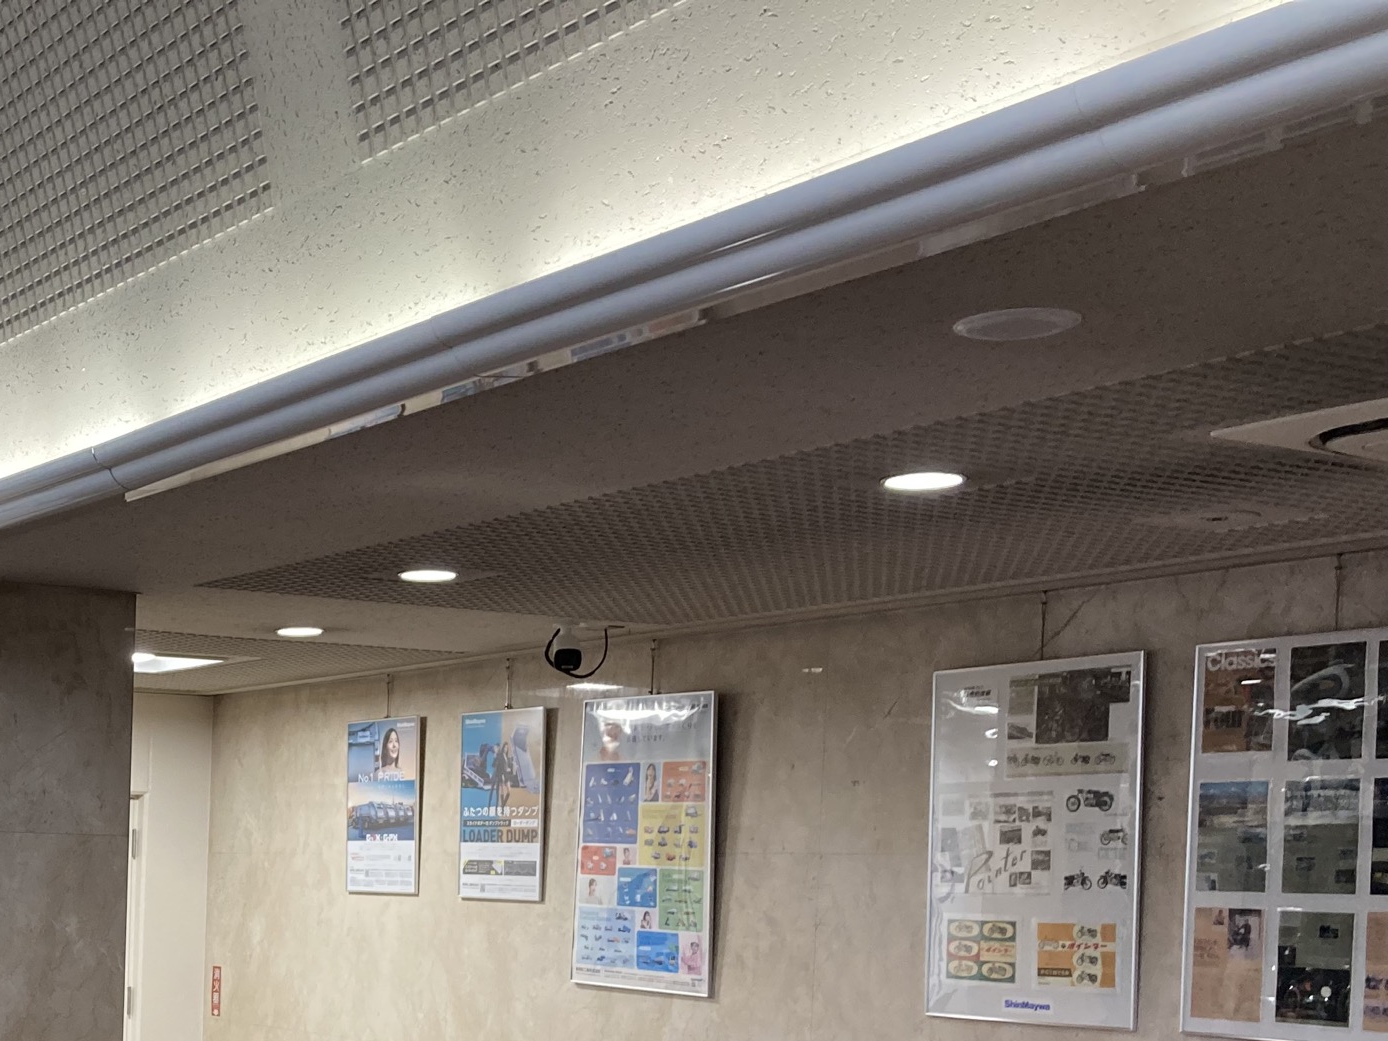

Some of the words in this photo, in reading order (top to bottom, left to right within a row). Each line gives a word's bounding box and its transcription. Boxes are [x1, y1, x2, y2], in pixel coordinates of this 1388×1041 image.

[378, 771, 405, 782] PRIDE
[462, 829, 504, 843] LOADER
[506, 829, 538, 843] DUMP
[964, 847, 1027, 894] Pointer
